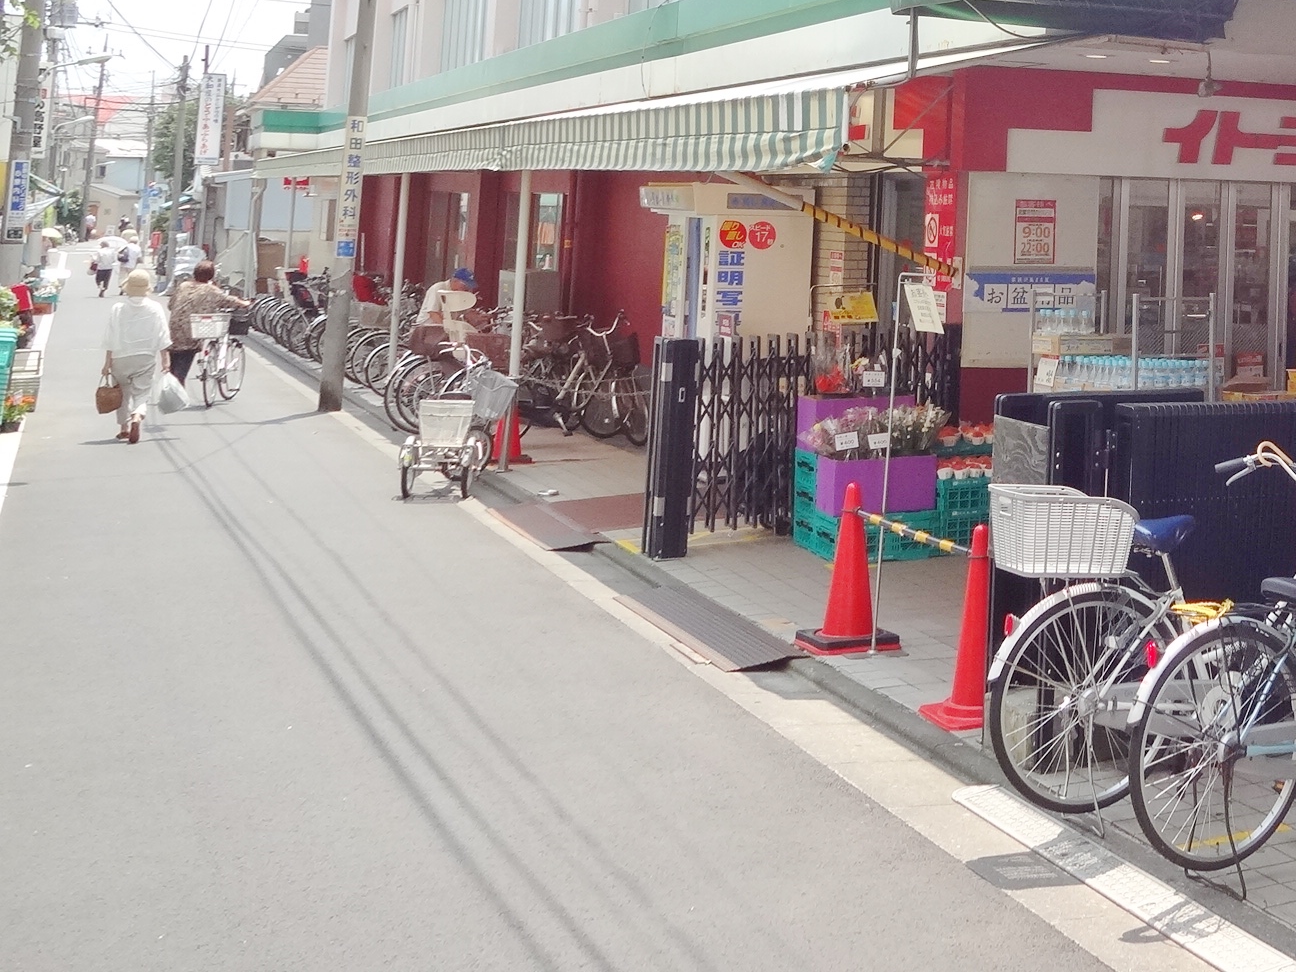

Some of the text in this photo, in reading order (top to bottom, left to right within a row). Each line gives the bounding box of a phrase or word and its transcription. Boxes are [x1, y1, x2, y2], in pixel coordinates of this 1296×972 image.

[342, 119, 364, 219] 和田整形外科
[749, 223, 772, 231] スピード
[1022, 226, 1051, 239] 9:00
[755, 231, 769, 243] 17
[731, 241, 747, 249] OK
[1020, 242, 1050, 254] 22:00
